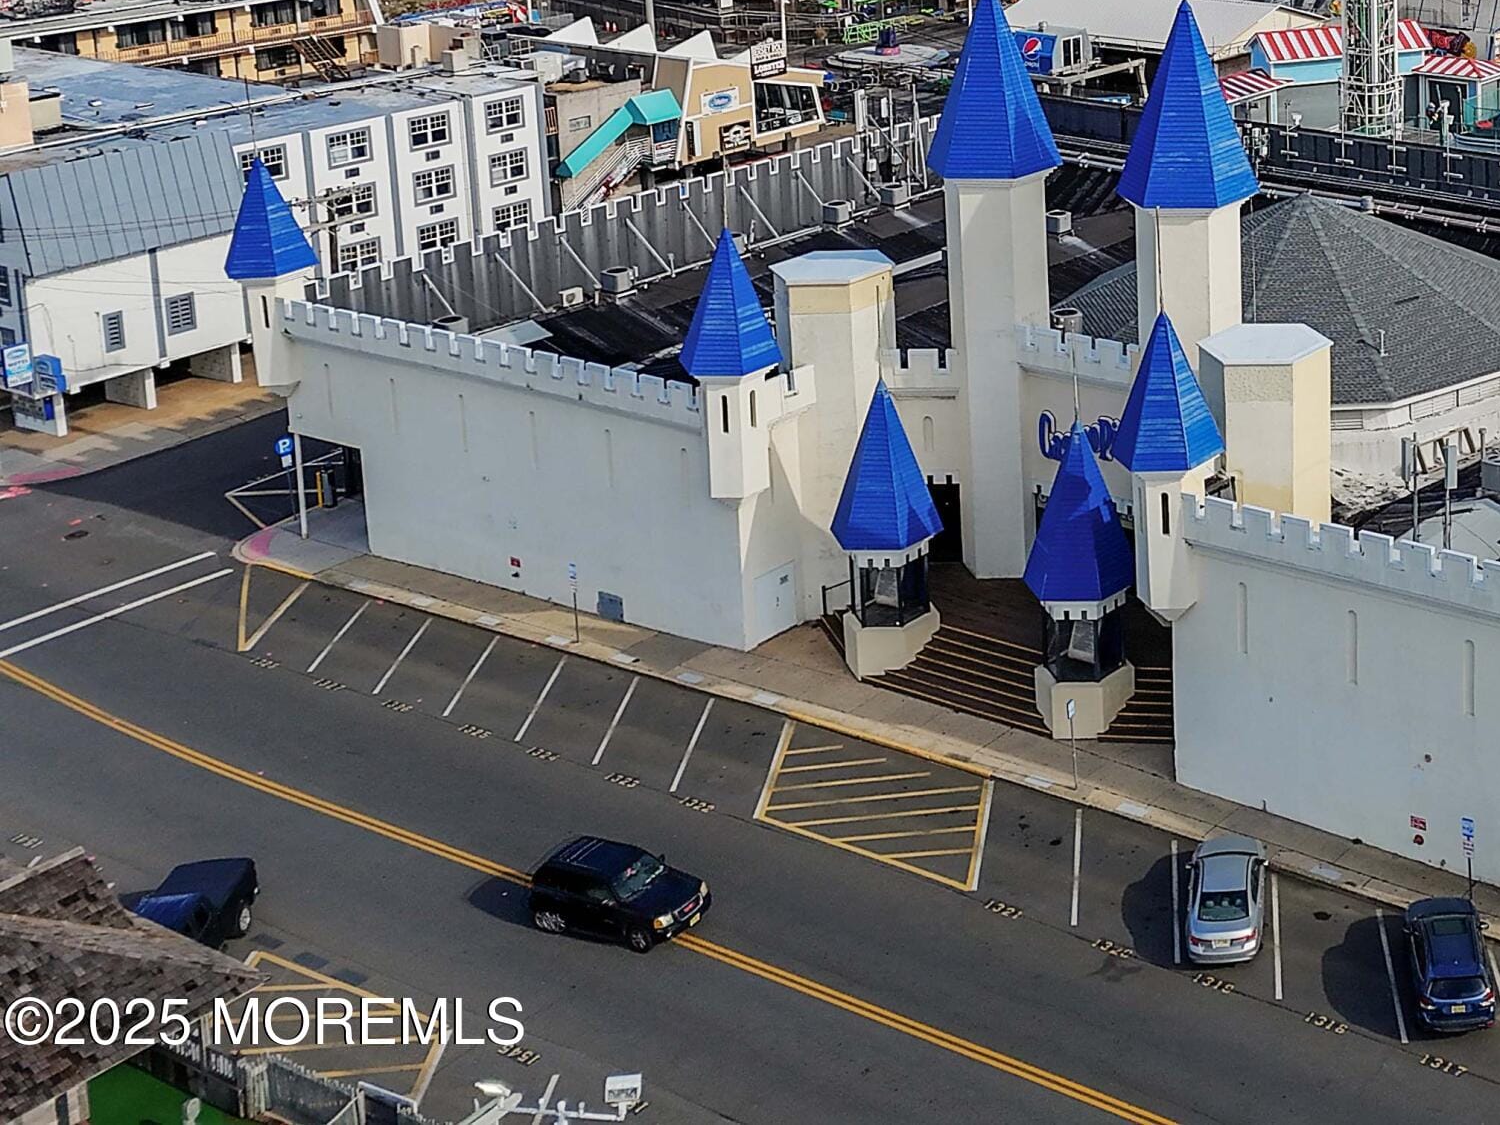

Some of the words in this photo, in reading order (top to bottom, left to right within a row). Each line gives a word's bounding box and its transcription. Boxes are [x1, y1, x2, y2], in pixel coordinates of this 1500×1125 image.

[458, 724, 492, 739] 1325
[526, 746, 560, 761] 1324
[604, 773, 640, 788] 1323
[679, 796, 715, 813] 1322
[984, 900, 1023, 920] 1321
[1420, 1054, 1468, 1076] 1317
